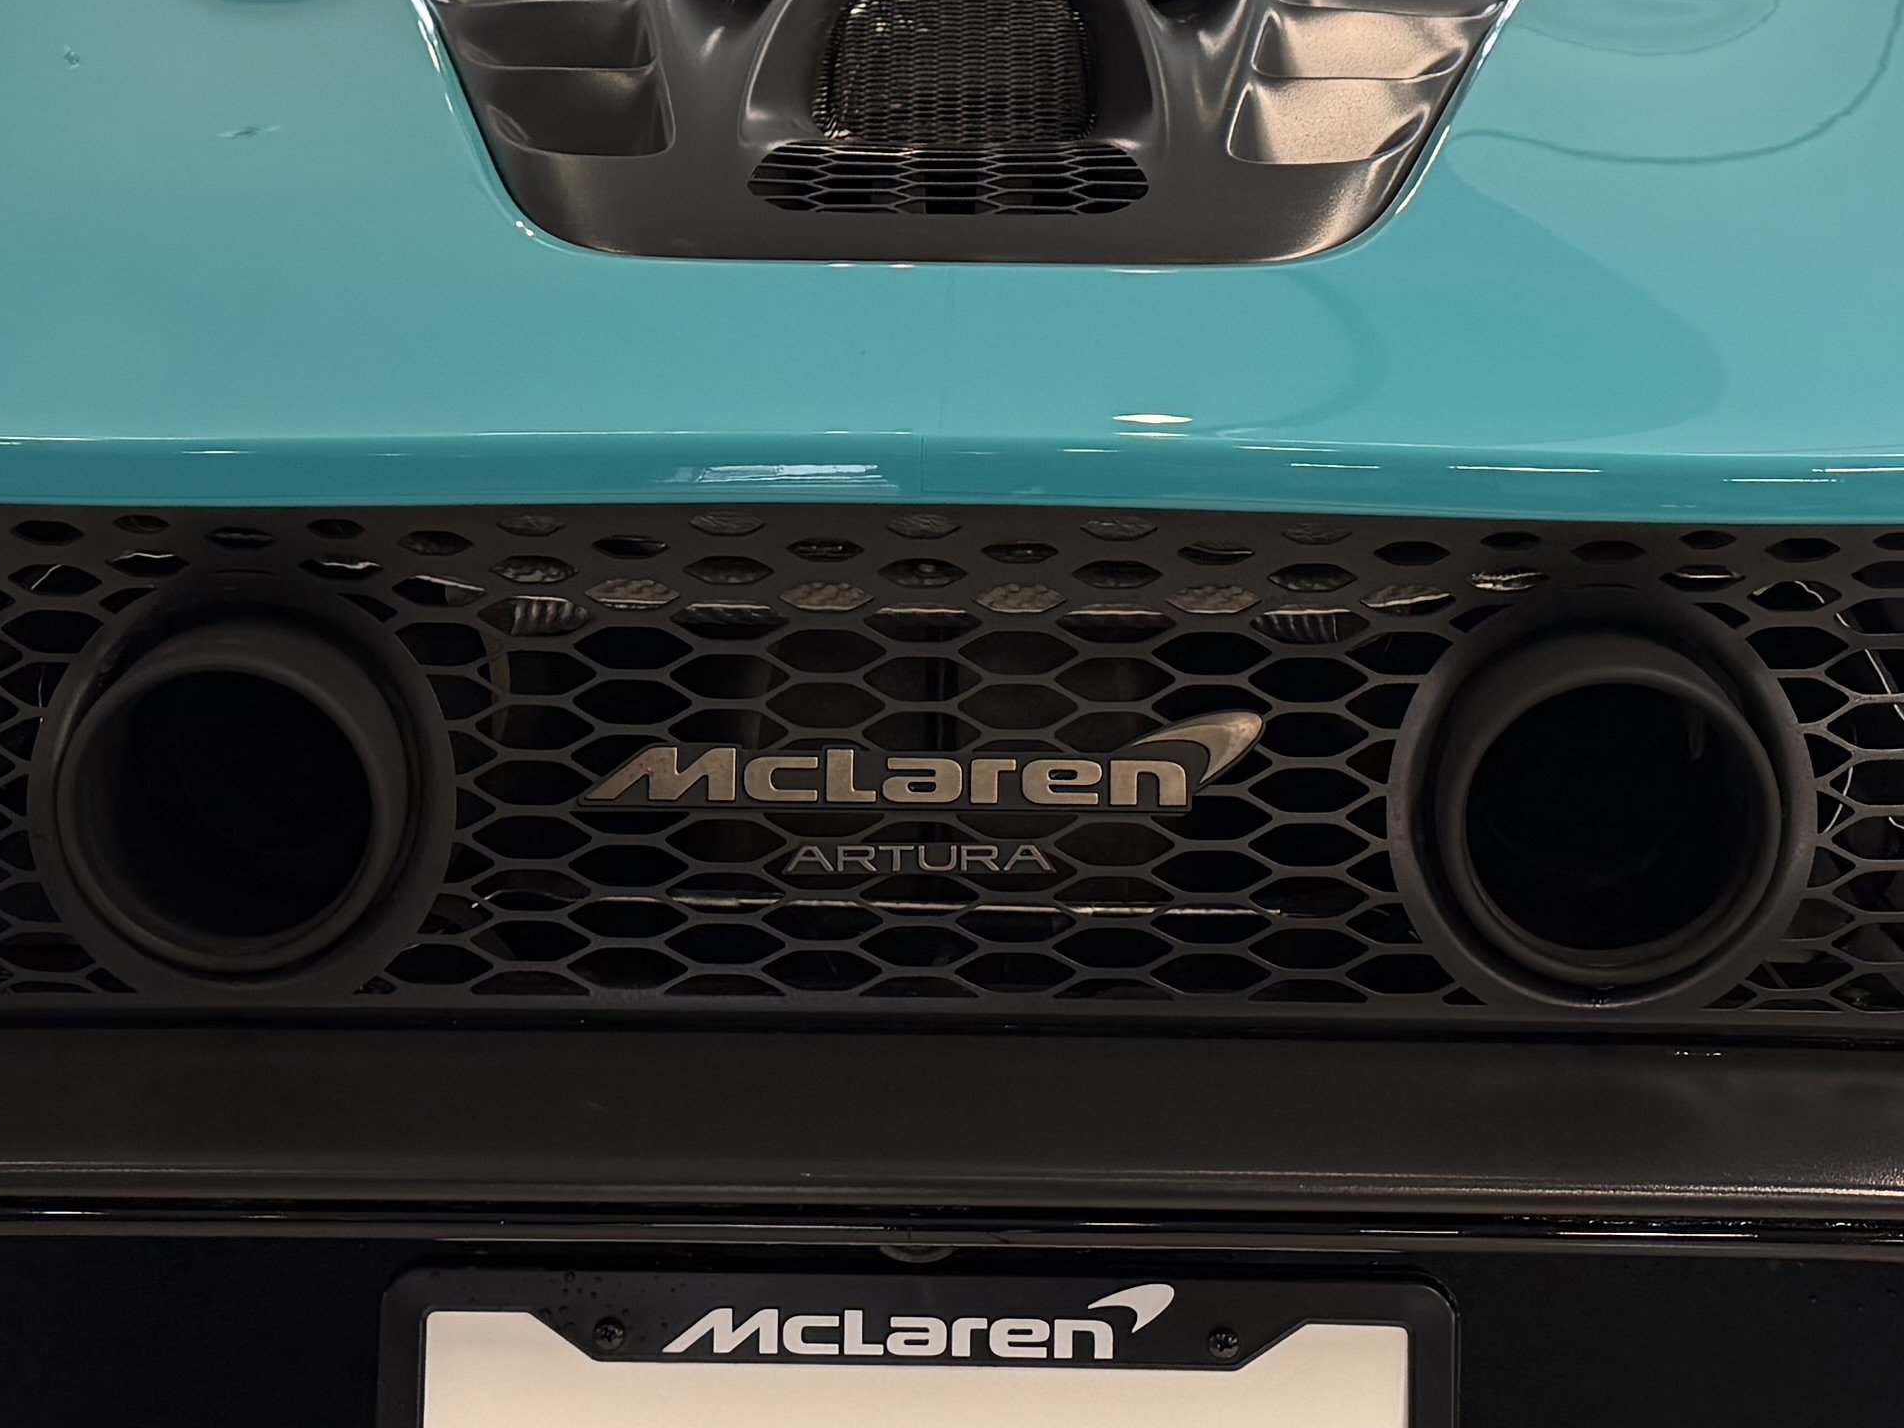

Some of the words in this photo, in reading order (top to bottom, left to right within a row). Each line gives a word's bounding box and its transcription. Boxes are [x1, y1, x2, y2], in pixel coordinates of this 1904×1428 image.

[582, 742, 1189, 808] McLaren
[786, 844, 1053, 874] ARTURA
[660, 1306, 1116, 1360] McLaren
